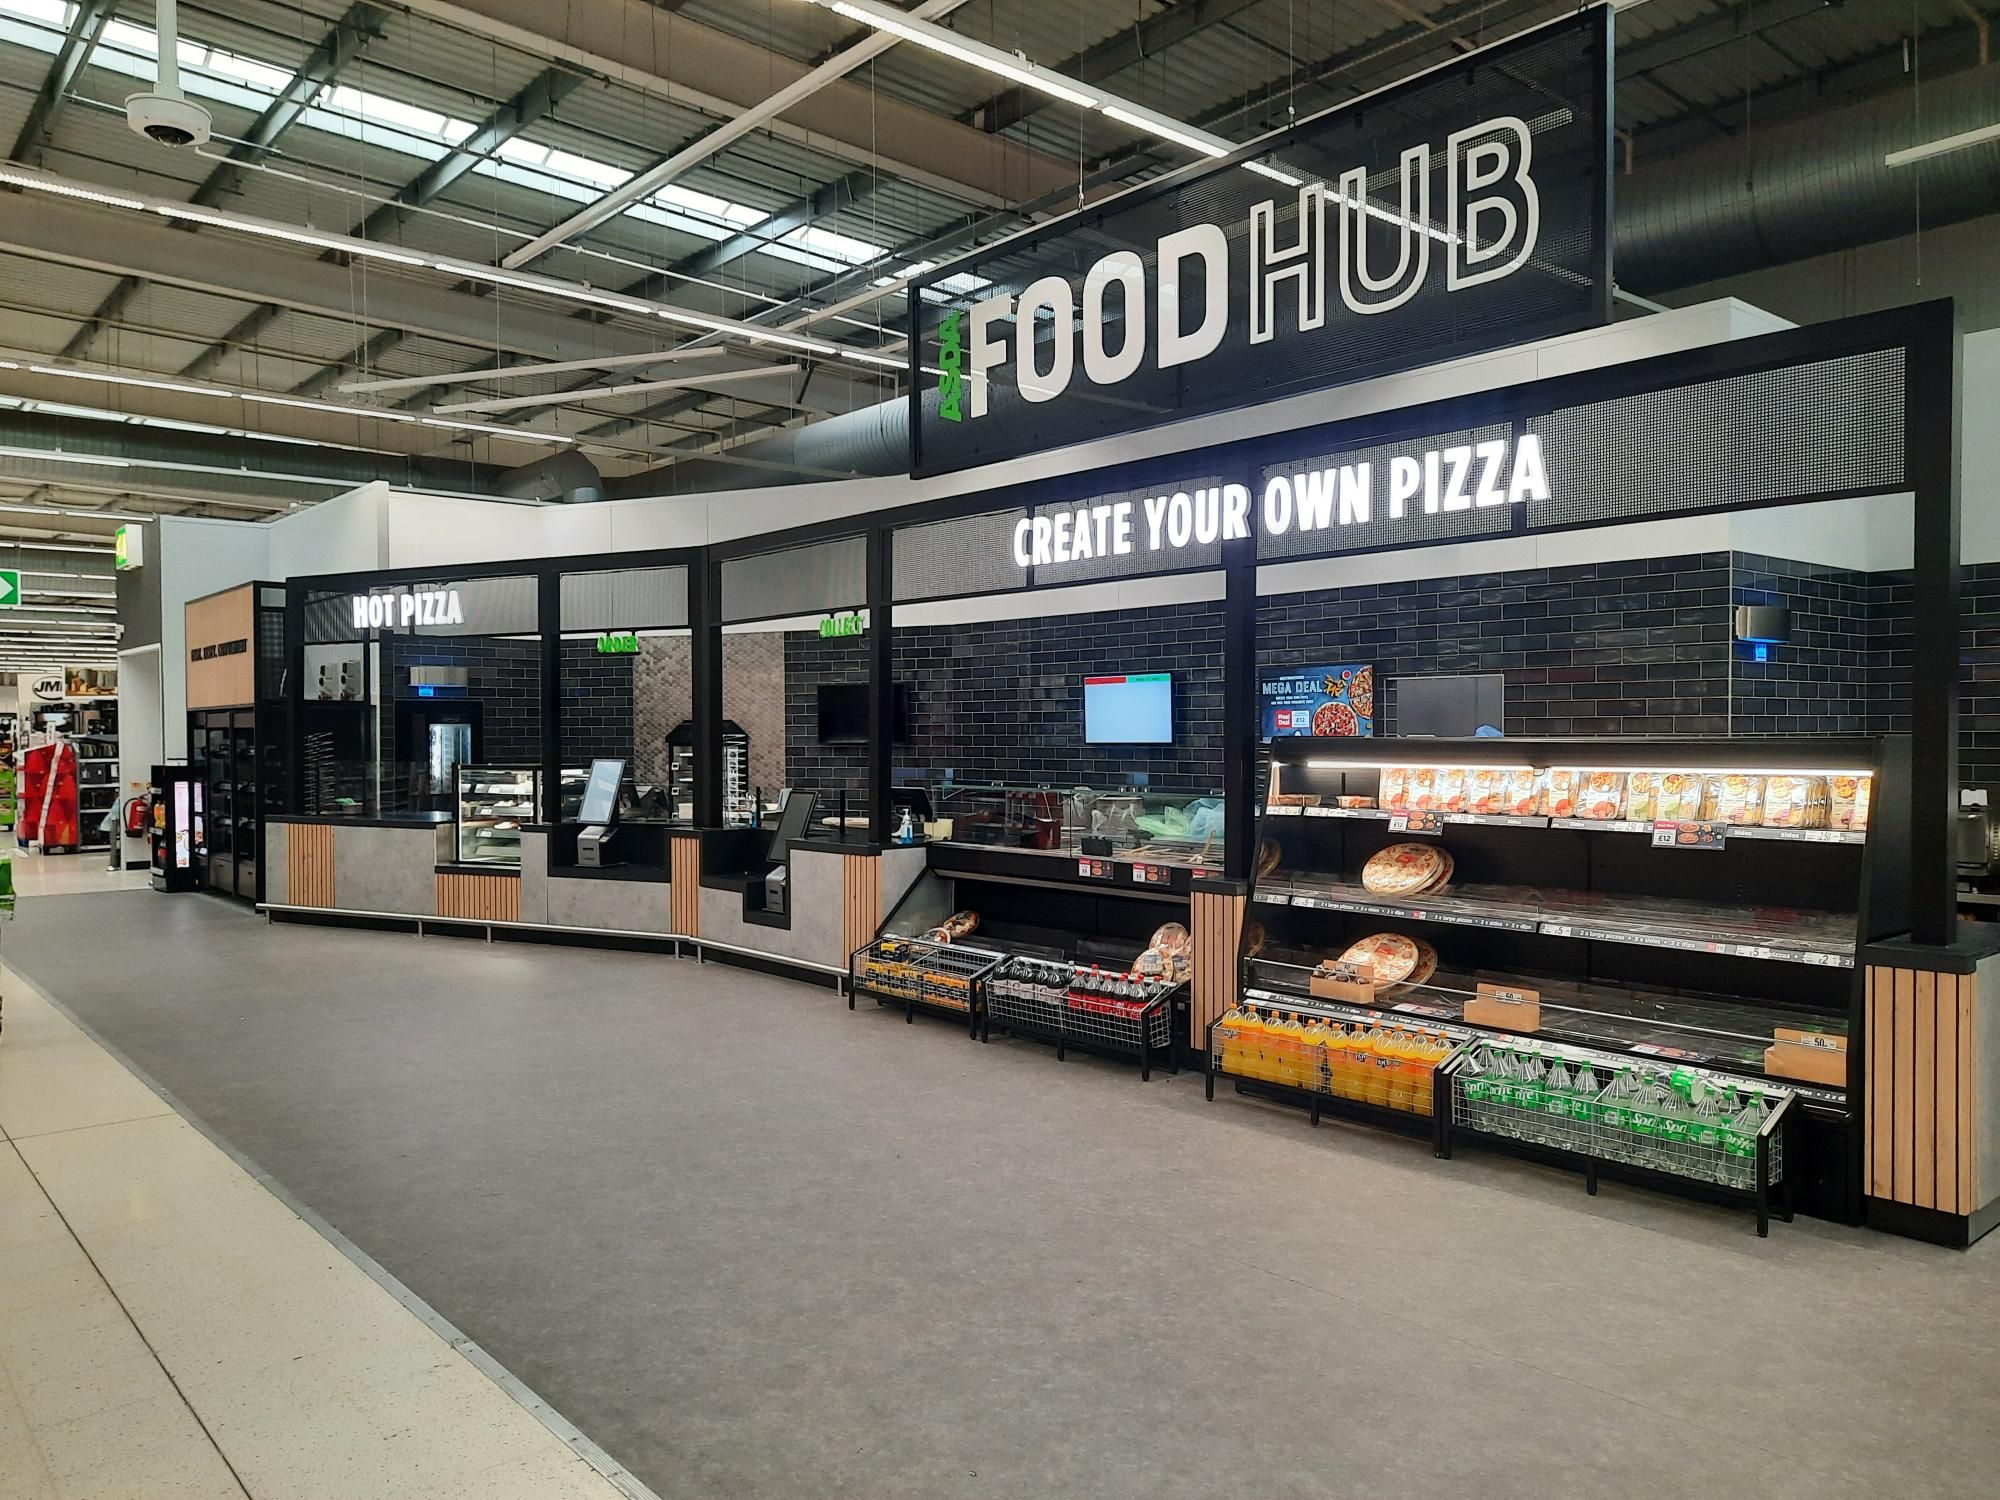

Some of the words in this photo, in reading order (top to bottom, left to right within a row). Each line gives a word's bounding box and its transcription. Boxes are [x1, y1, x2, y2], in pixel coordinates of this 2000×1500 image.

[969, 223, 1229, 419] FOOD
[1248, 116, 1540, 345] HUB
[938, 309, 963, 423] ASDA
[1013, 501, 1134, 567] CREATE
[1144, 483, 1253, 550] YOUR
[1263, 462, 1373, 536] OWN
[1389, 434, 1551, 518] PIZZA
[352, 594, 395, 628] HOT
[400, 590, 464, 627] PIZZA
[819, 615, 865, 638] COLLECT
[597, 635, 639, 653] ORDER
[1262, 682, 1292, 695] MEGA
[1295, 681, 1323, 693] DEAL
[1780, 831, 1800, 839] Sides
[1725, 1133, 1756, 1150] prite
